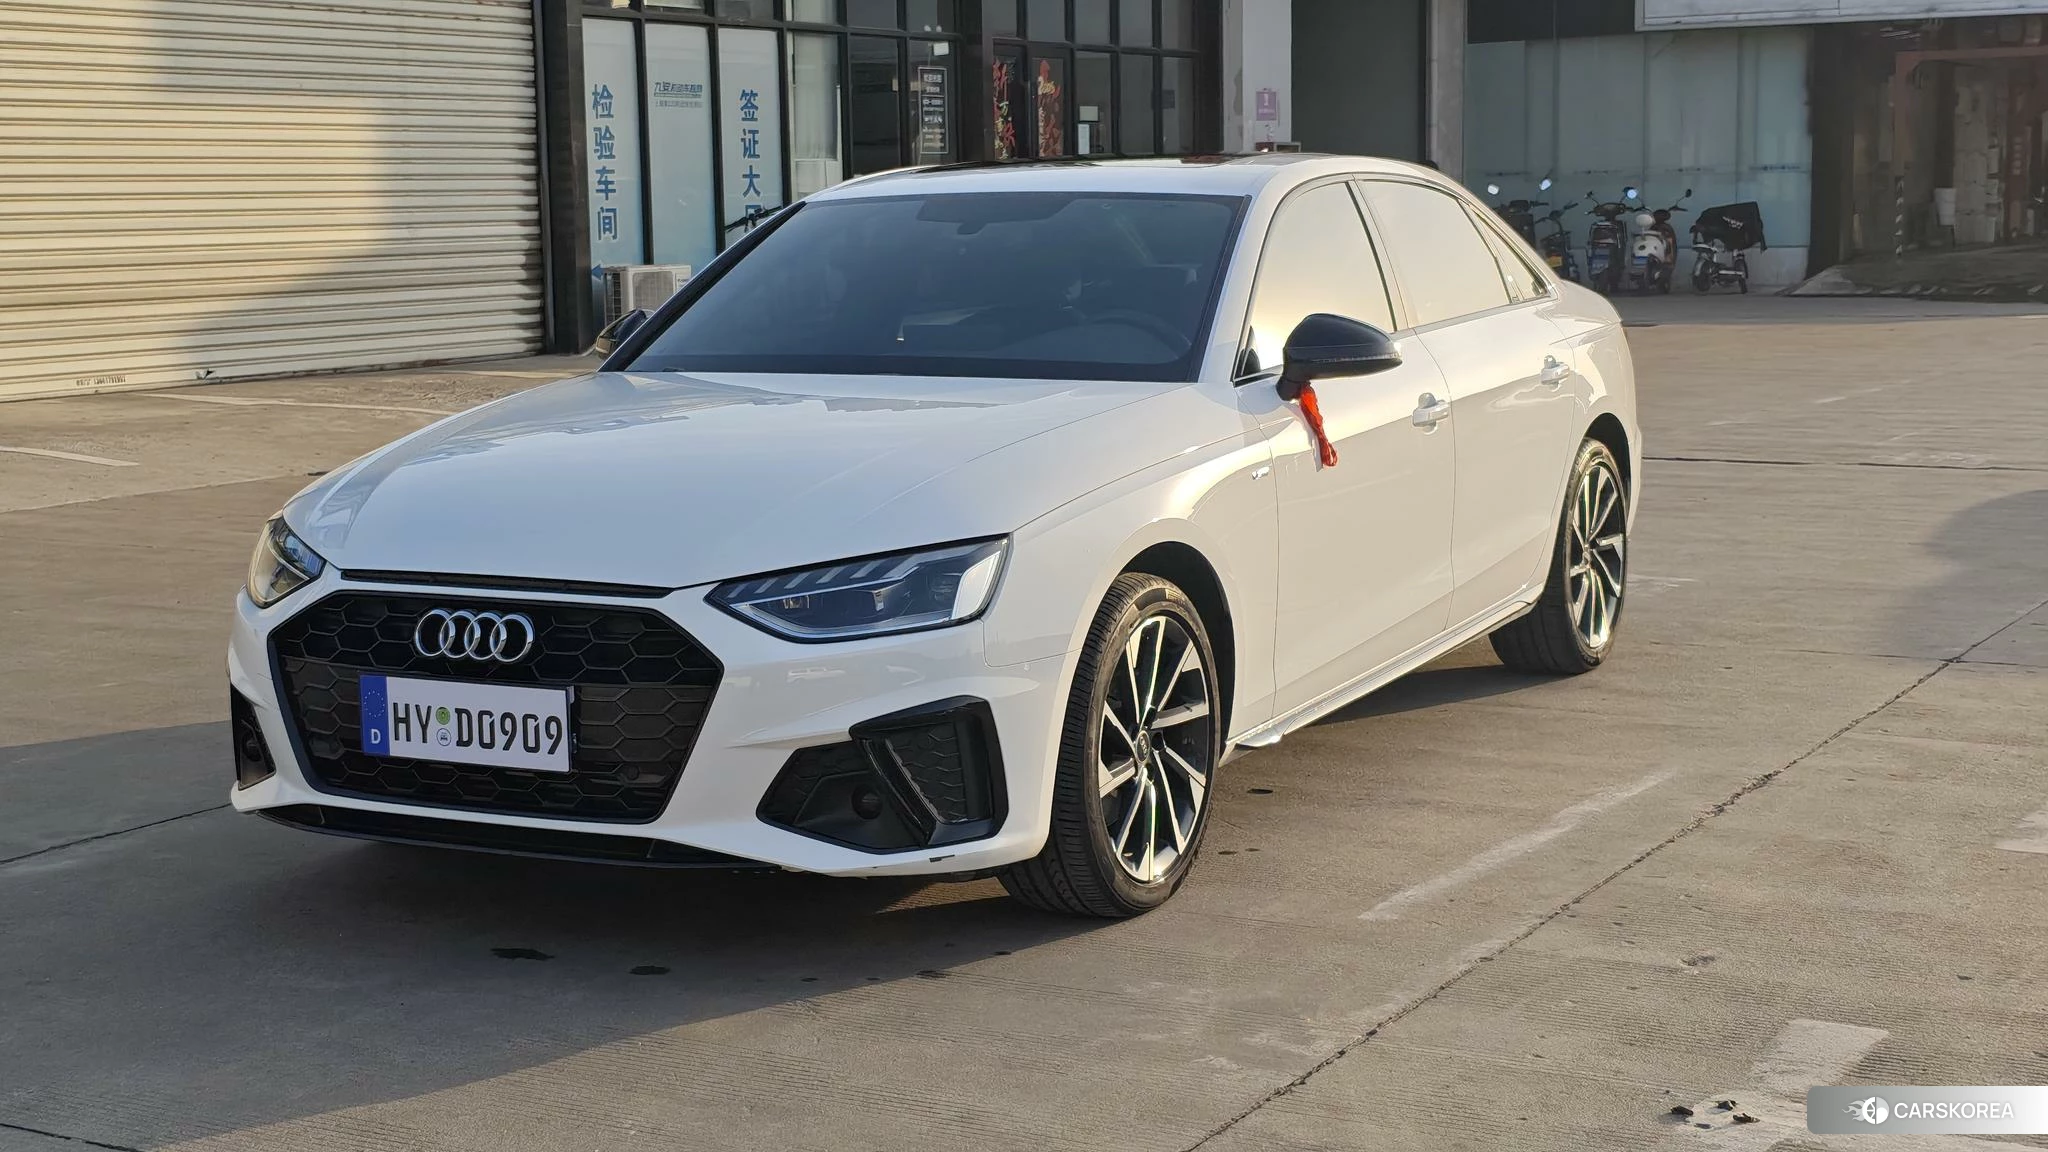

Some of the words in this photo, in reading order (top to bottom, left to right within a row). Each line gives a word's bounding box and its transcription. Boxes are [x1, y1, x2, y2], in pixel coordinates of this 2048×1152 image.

[592, 84, 619, 240] 检验车间
[371, 728, 382, 744] D
[393, 702, 432, 743] HY
[455, 708, 563, 755] D0909
